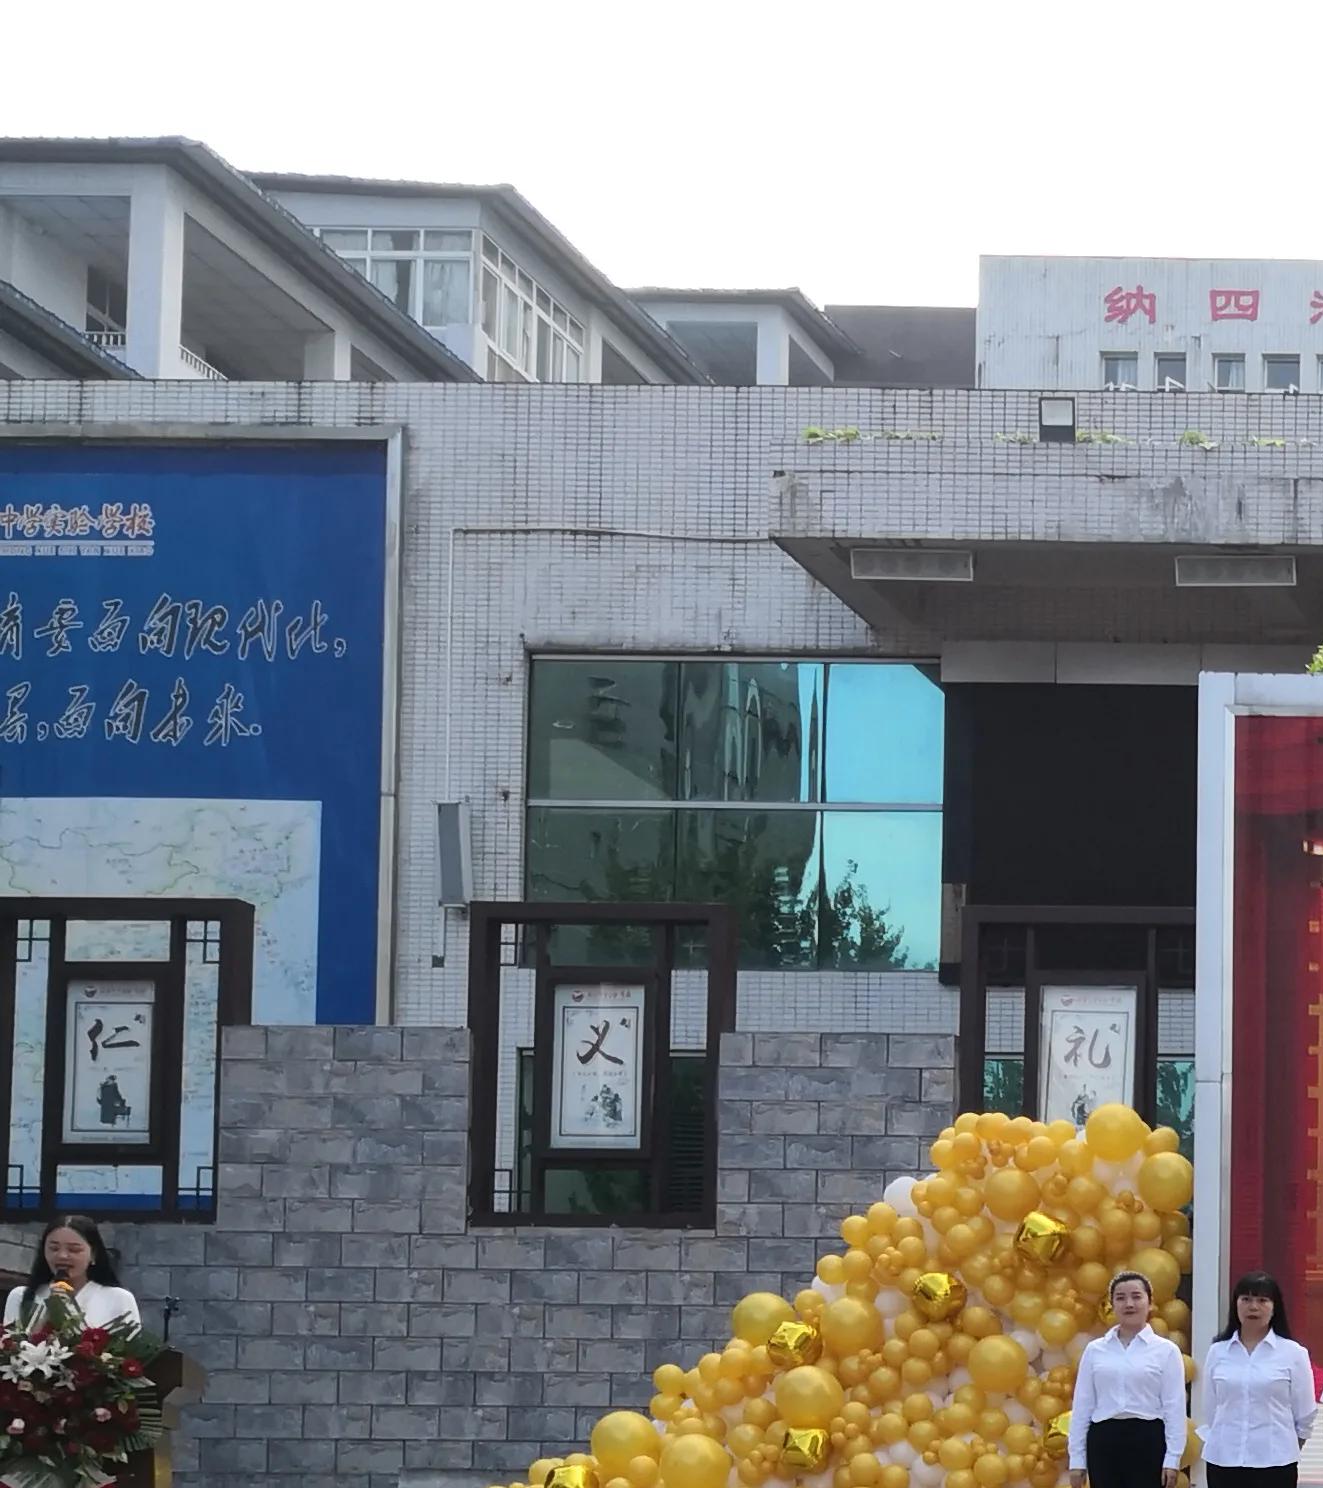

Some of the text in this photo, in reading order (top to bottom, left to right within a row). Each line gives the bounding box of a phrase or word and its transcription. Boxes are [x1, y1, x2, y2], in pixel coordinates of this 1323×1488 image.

[87, 1018, 140, 1061] 仁
[576, 1019, 624, 1064] 义
[1064, 1025, 1111, 1069] 礼
